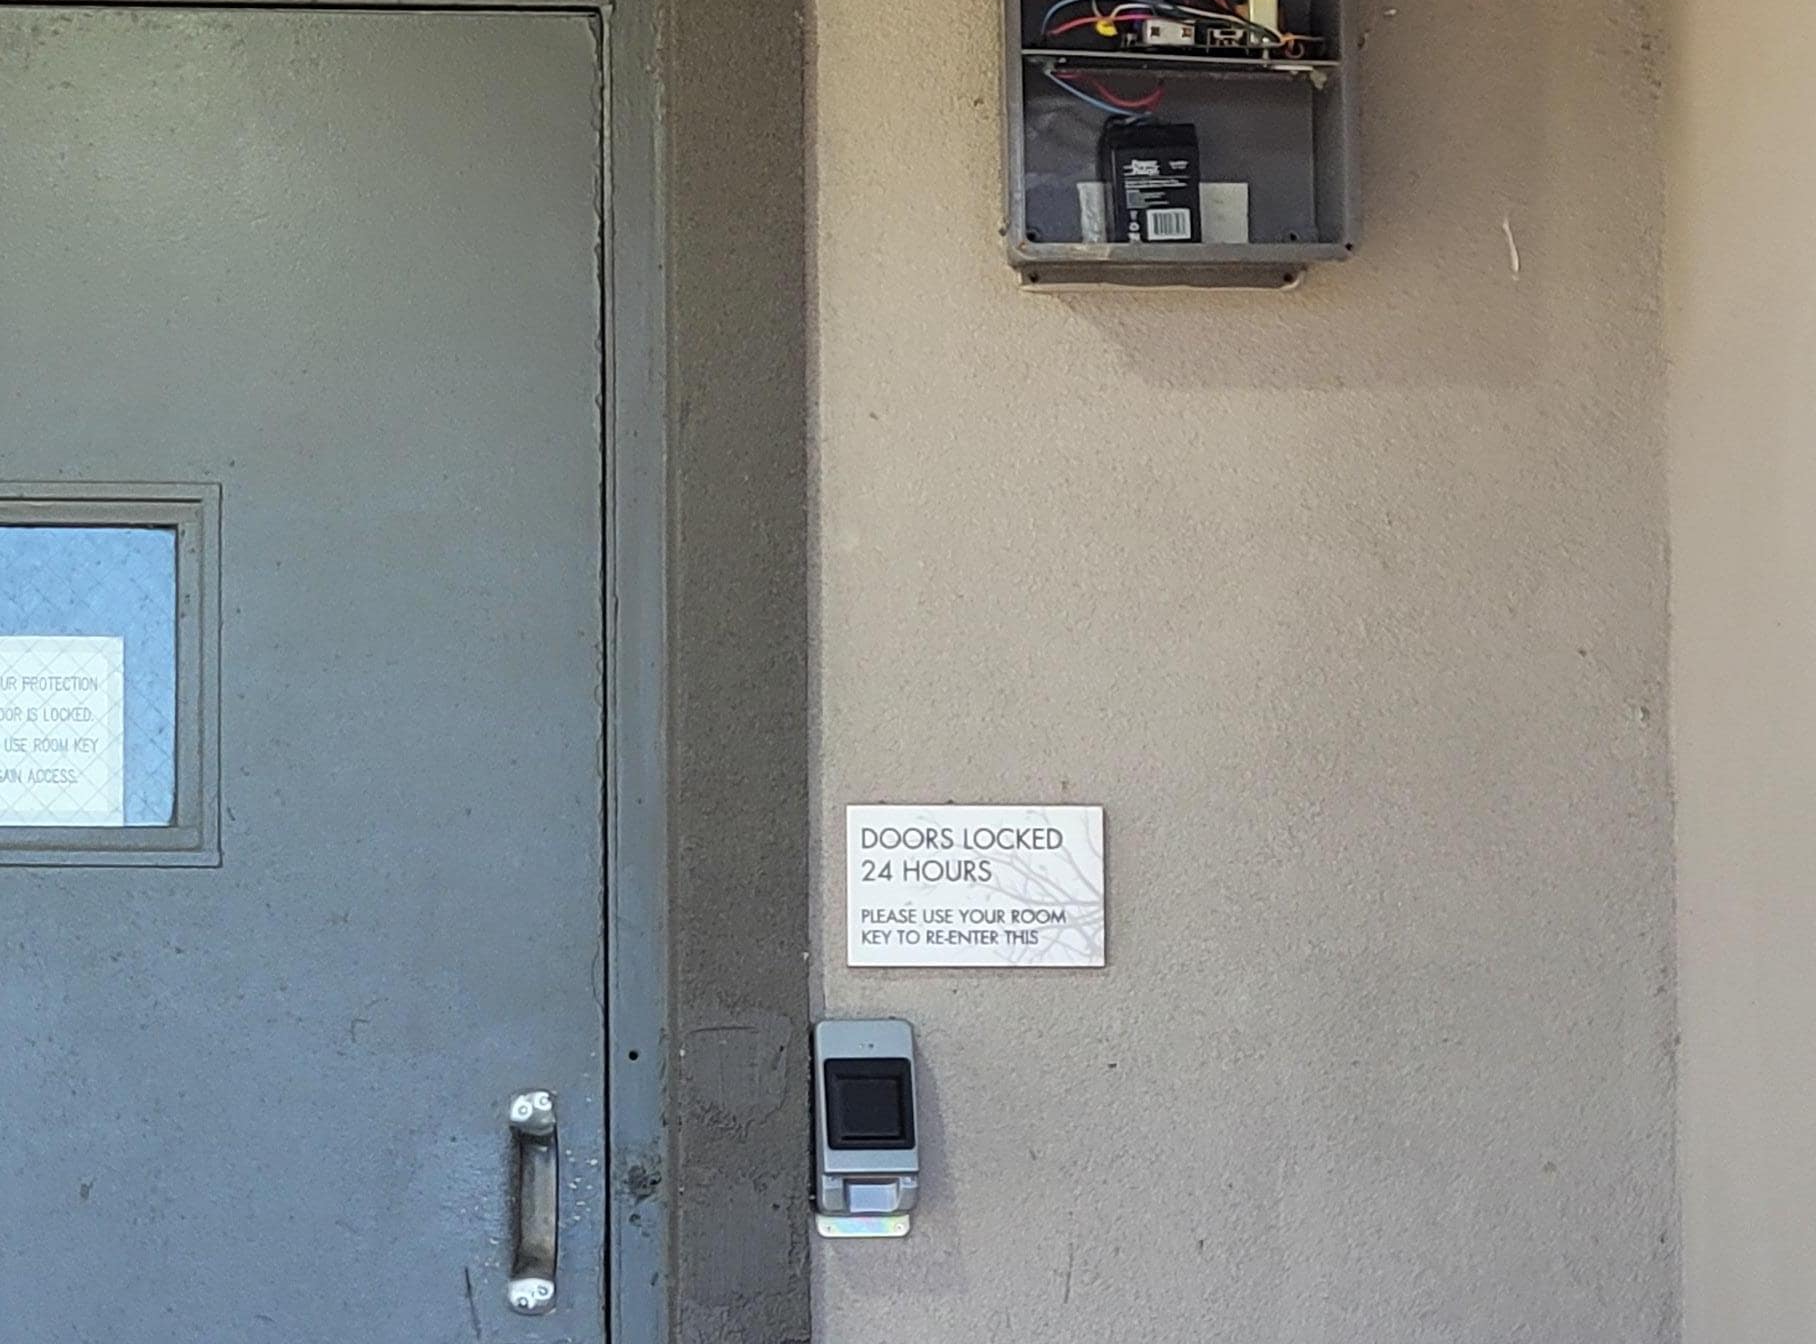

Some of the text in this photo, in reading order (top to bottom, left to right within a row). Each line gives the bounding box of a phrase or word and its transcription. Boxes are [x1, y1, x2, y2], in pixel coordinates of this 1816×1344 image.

[22, 676, 98, 692] PROTECTION
[26, 706, 38, 722] IS
[4, 737, 99, 753] USE ROOM KEY
[861, 827, 1064, 850] DOORS LOCKED
[861, 859, 992, 883] 24 HOURS
[861, 909, 1067, 924] PLEASE USE YOUR ROOM
[861, 930, 1039, 945] KEY TO RE-ENTER THIS
